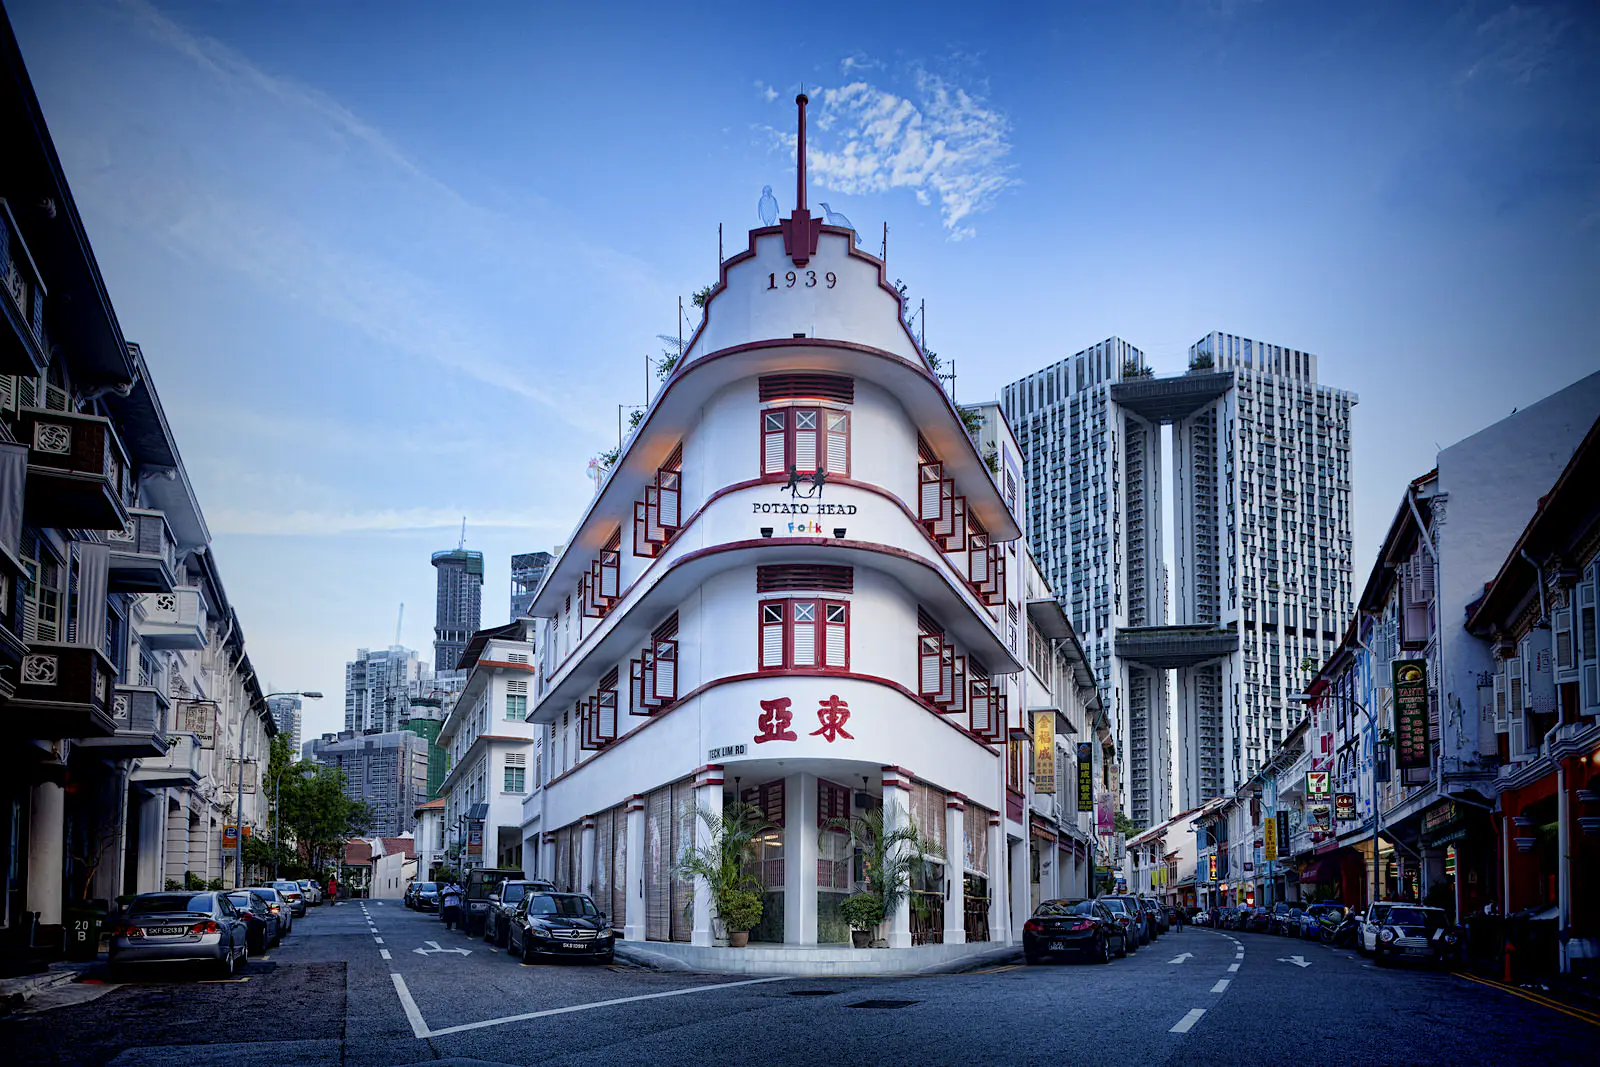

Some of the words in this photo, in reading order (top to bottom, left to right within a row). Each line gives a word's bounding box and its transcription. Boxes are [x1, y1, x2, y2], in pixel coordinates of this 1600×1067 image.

[766, 270, 837, 291] 1939
[752, 503, 809, 514] POTATO
[817, 504, 858, 515] HEAD
[787, 520, 823, 534] Folk
[709, 748, 721, 760] TECK
[722, 746, 733, 757] LIM
[735, 745, 744, 756] RD
[74, 920, 89, 930] 20
[77, 931, 87, 942] B
